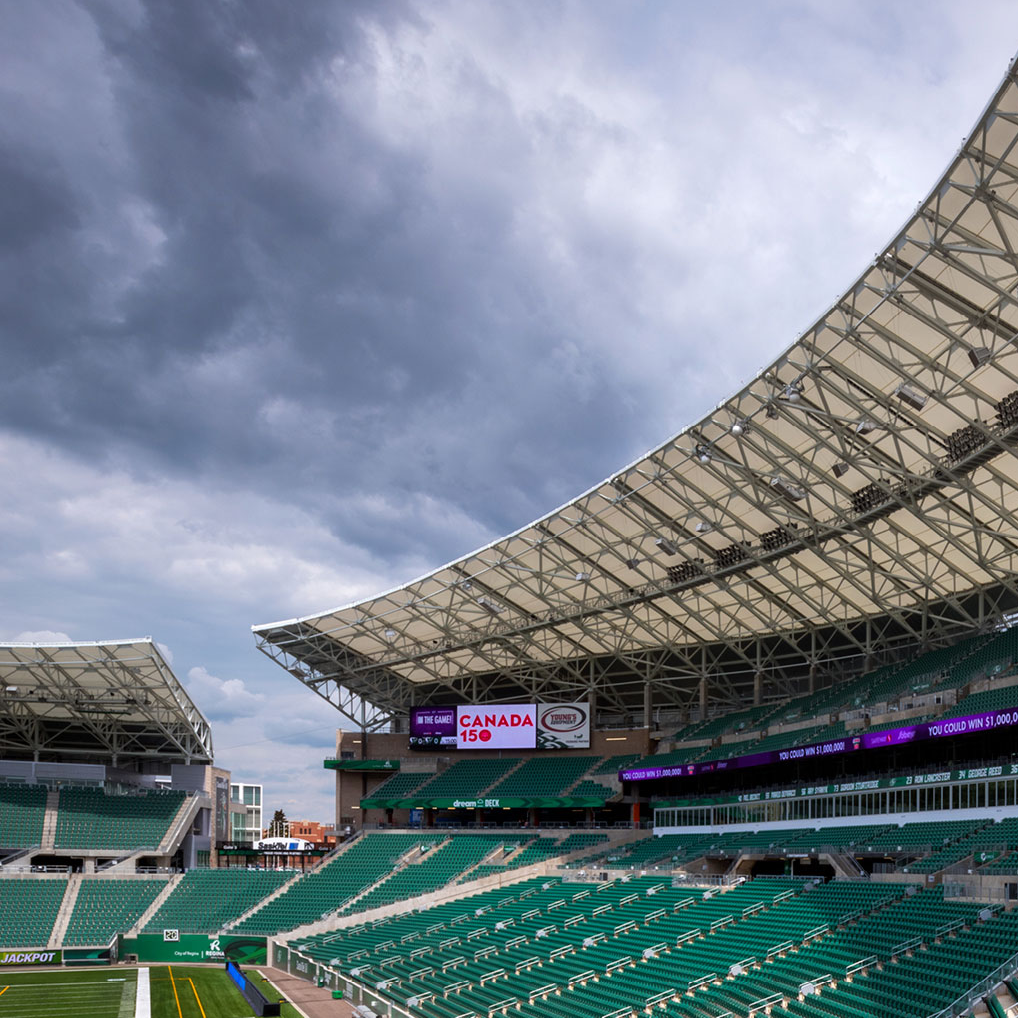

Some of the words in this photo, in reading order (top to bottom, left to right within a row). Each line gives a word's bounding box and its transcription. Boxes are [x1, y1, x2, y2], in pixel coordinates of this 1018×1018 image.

[424, 716, 434, 724] THE
[459, 714, 534, 728] CANADA
[928, 726, 942, 736] YOU
[944, 721, 967, 733] COULD
[968, 718, 984, 729] WIN
[780, 752, 788, 760] YOU
[790, 749, 804, 759] COULD
[805, 748, 816, 757] WIN
[923, 772, 950, 782] LANCASTER
[968, 768, 987, 778] GEORGE
[988, 766, 1002, 776] REED
[485, 799, 500, 807] DECK
[258, 842, 288, 850] SaskTel
[0, 952, 56, 963] JACKPOT
